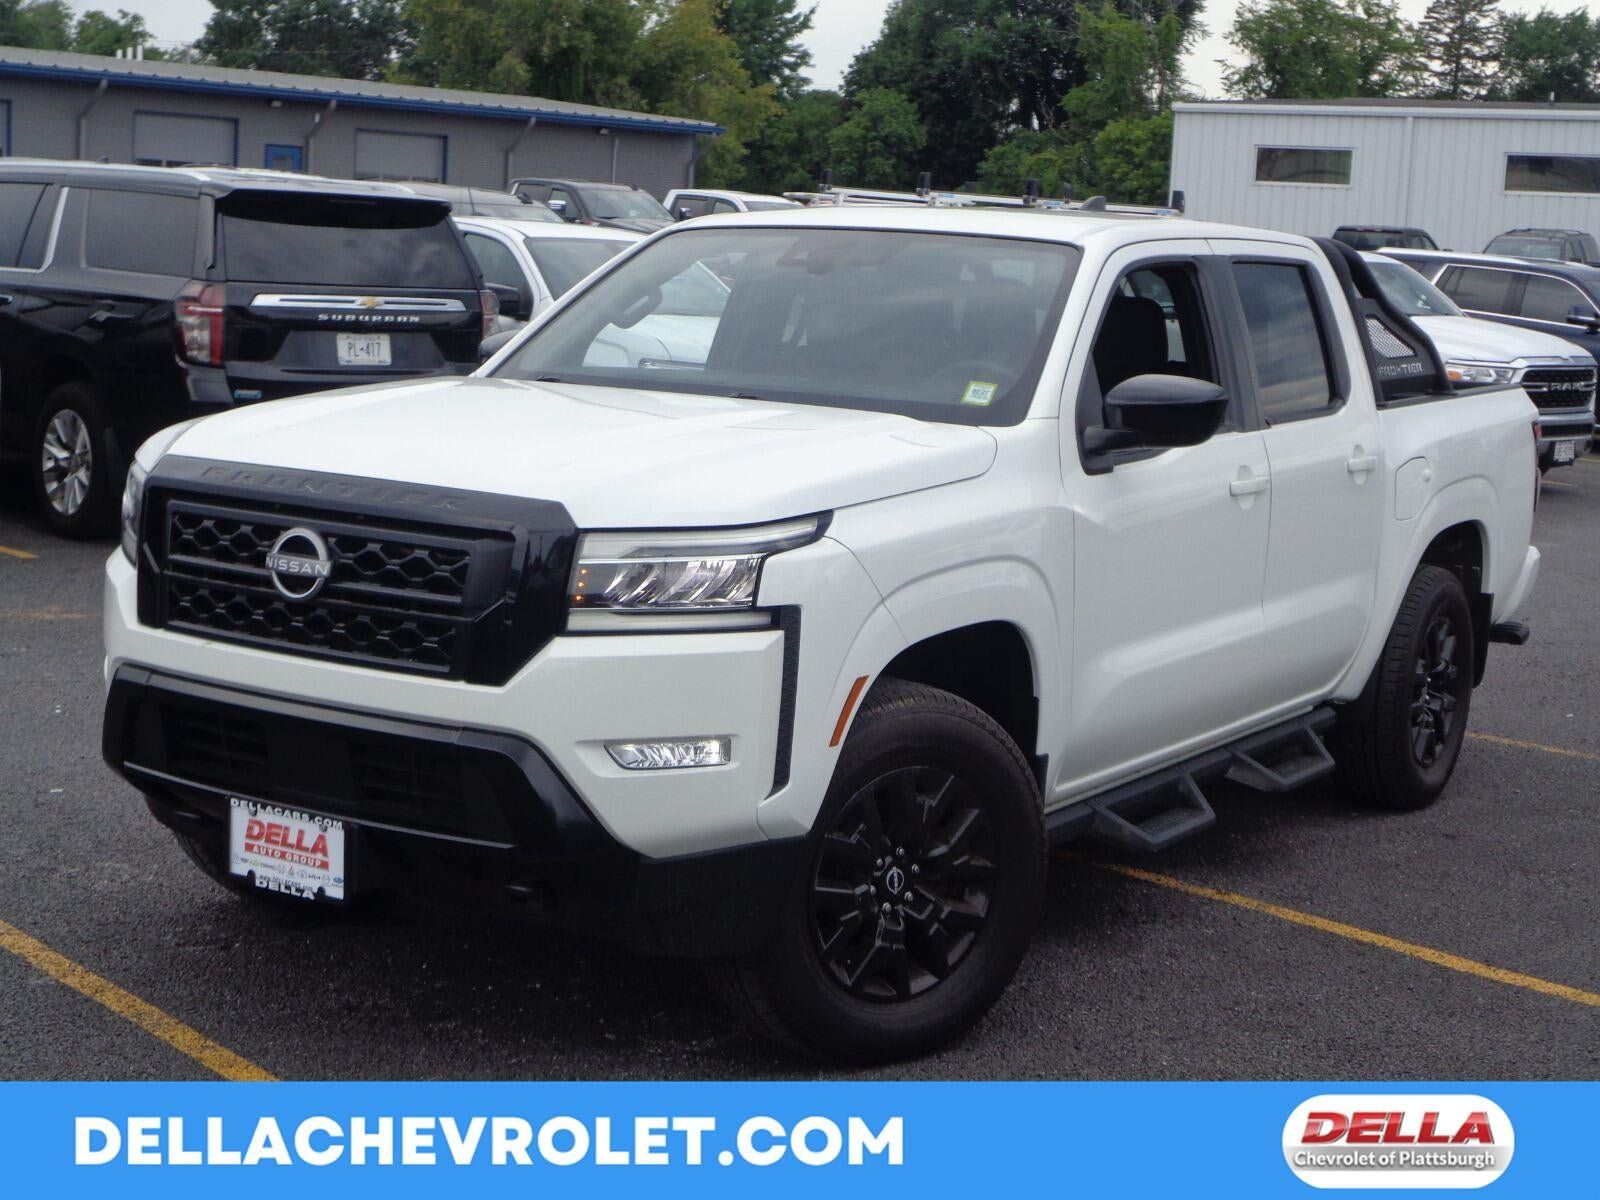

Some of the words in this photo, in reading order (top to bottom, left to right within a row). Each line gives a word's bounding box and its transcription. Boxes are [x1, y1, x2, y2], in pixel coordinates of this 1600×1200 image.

[318, 313, 420, 322] SUBURBAN
[1378, 363, 1423, 376] FRONTIER
[1551, 382, 1584, 392] RAM
[201, 464, 466, 510] FRONTIER
[266, 553, 329, 576] NISSAN
[230, 798, 343, 830] DELLACARS.COM
[245, 818, 329, 858] DELLA
[252, 845, 281, 858] AUTO
[285, 853, 321, 867] GROUP
[255, 880, 315, 900] DELLA
